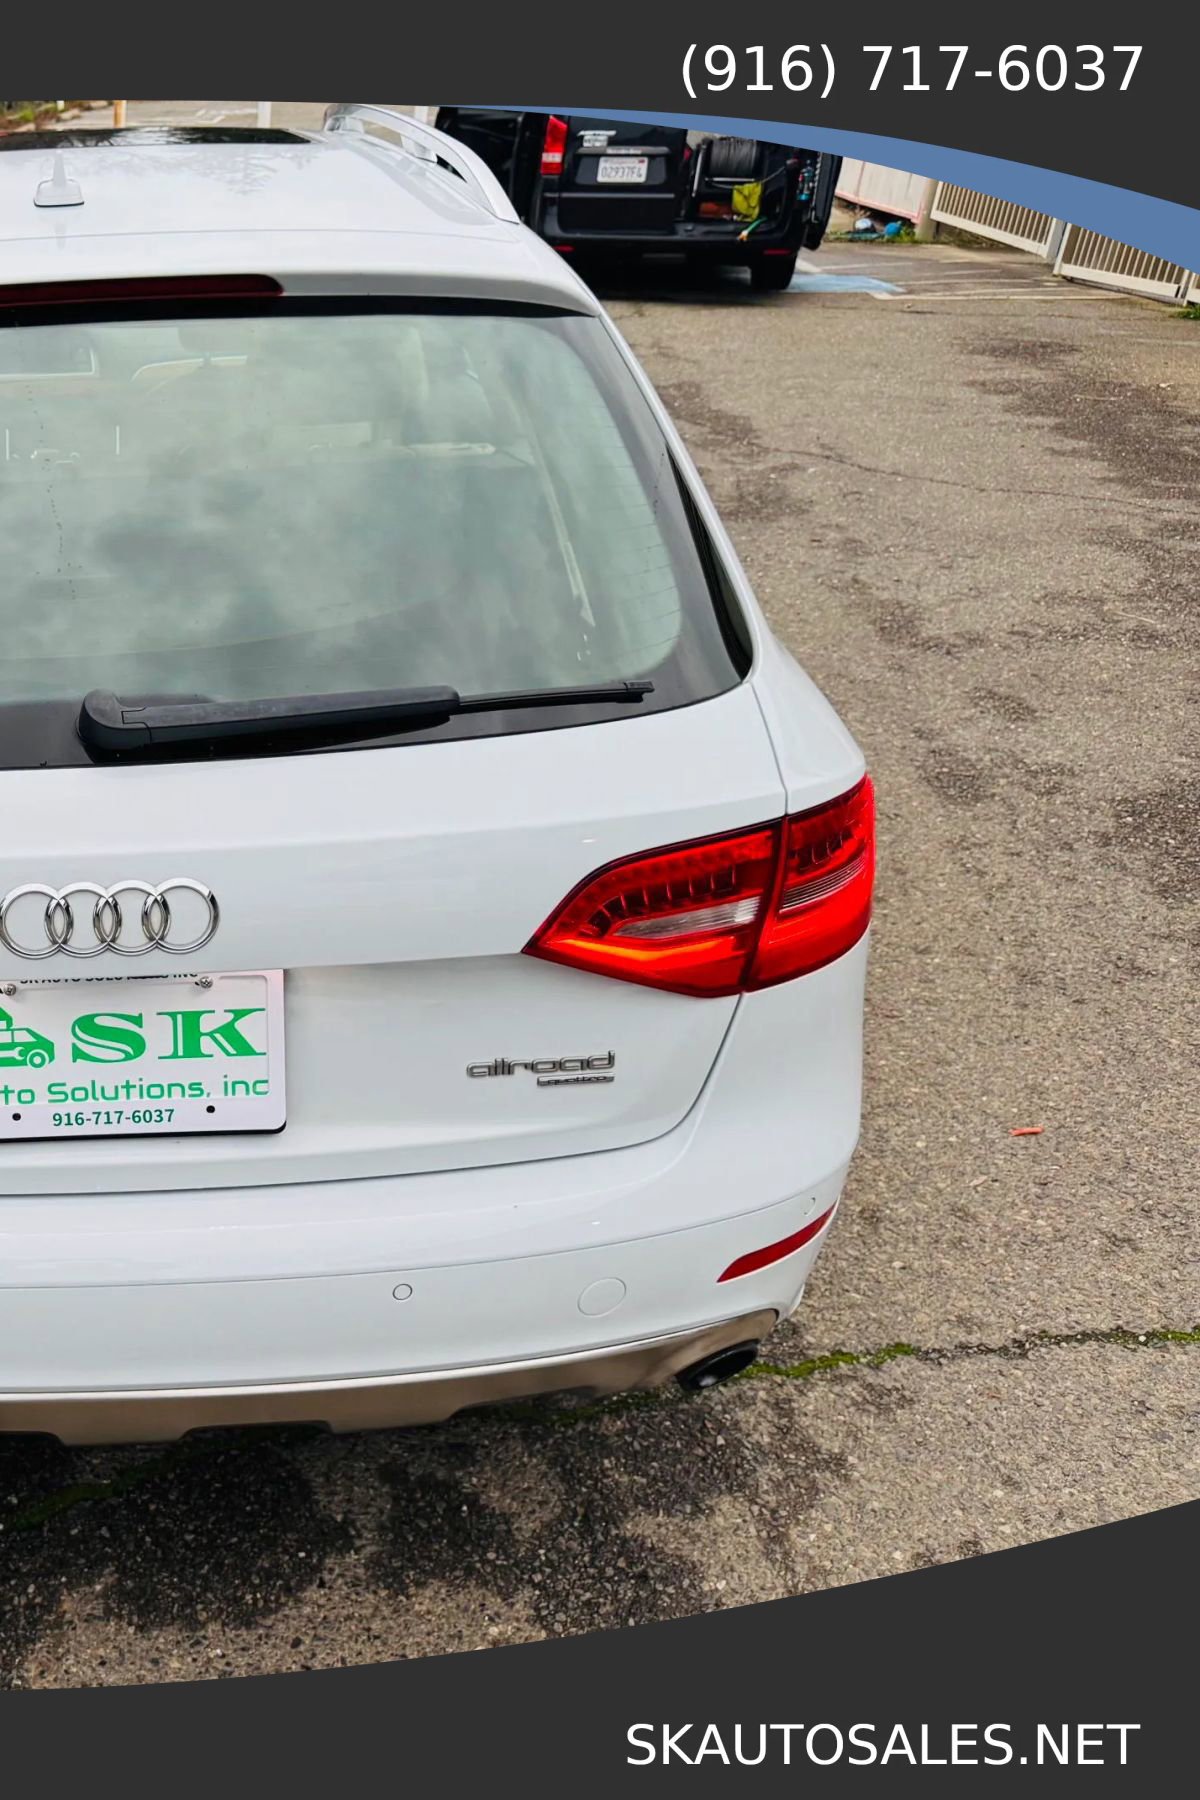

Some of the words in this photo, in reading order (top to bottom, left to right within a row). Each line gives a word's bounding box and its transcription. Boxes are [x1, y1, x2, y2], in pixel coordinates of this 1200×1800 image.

[70, 1007, 267, 1065] SK
[466, 1050, 616, 1078] allroad
[46, 1076, 212, 1105] Solutions,
[222, 1074, 269, 1097] inc
[52, 1107, 176, 1128] 916-717-6037
